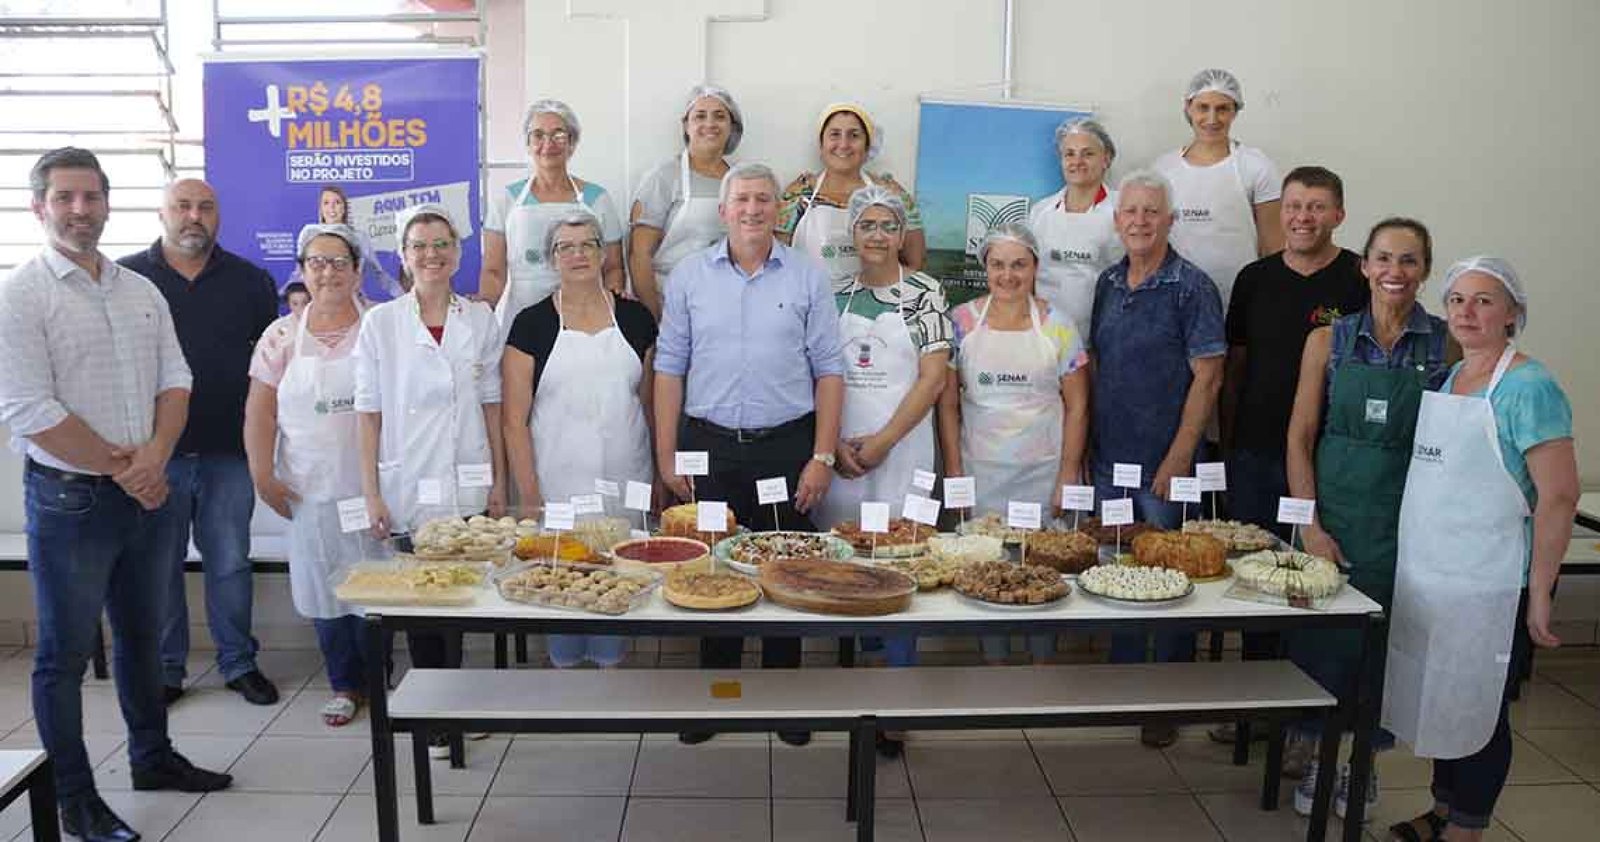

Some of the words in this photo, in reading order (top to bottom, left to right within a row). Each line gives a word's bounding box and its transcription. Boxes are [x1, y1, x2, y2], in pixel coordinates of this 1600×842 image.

[287, 80, 329, 117] R$
[334, 83, 383, 115] 4,8
[288, 111, 428, 148] MILHÕES
[290, 152, 332, 167] SERÃO
[334, 153, 410, 166] INVESTIDOS
[290, 168, 311, 181] NO
[312, 168, 373, 181] PROJETO
[374, 197, 406, 214] AQUI
[408, 190, 441, 205] TEM
[1183, 208, 1210, 217] SENAR
[997, 374, 1028, 382] SENAR
